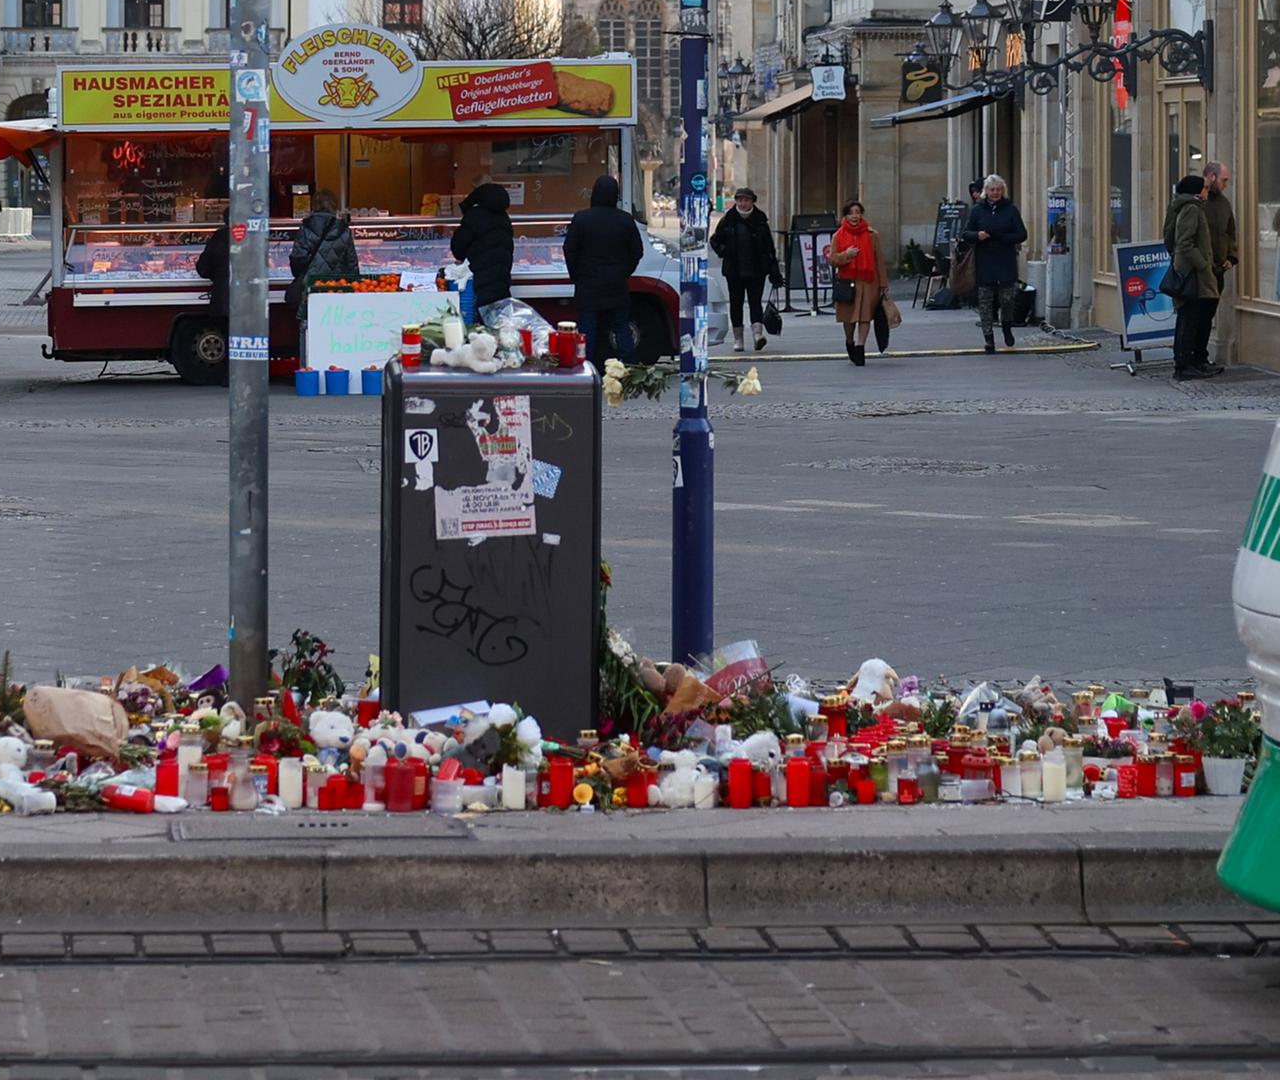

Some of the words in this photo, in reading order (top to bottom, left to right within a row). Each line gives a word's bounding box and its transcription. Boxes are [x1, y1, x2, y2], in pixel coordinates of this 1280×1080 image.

[282, 27, 414, 75] FLEISCHEREI
[322, 58, 375, 66] OBERLÄNDER
[73, 76, 216, 91] HAUSMACHER
[438, 73, 470, 88] NEU
[460, 86, 492, 100] Original
[493, 78, 544, 94] Magdeburger
[113, 89, 230, 108] SPEZIALITÄ
[455, 90, 553, 116] Geflügelkroketten
[113, 111, 133, 119] aus
[135, 110, 177, 120] eigener
[180, 110, 231, 119] Produktio
[1132, 251, 1171, 265] PREMIU
[229, 336, 269, 349] TRAS
